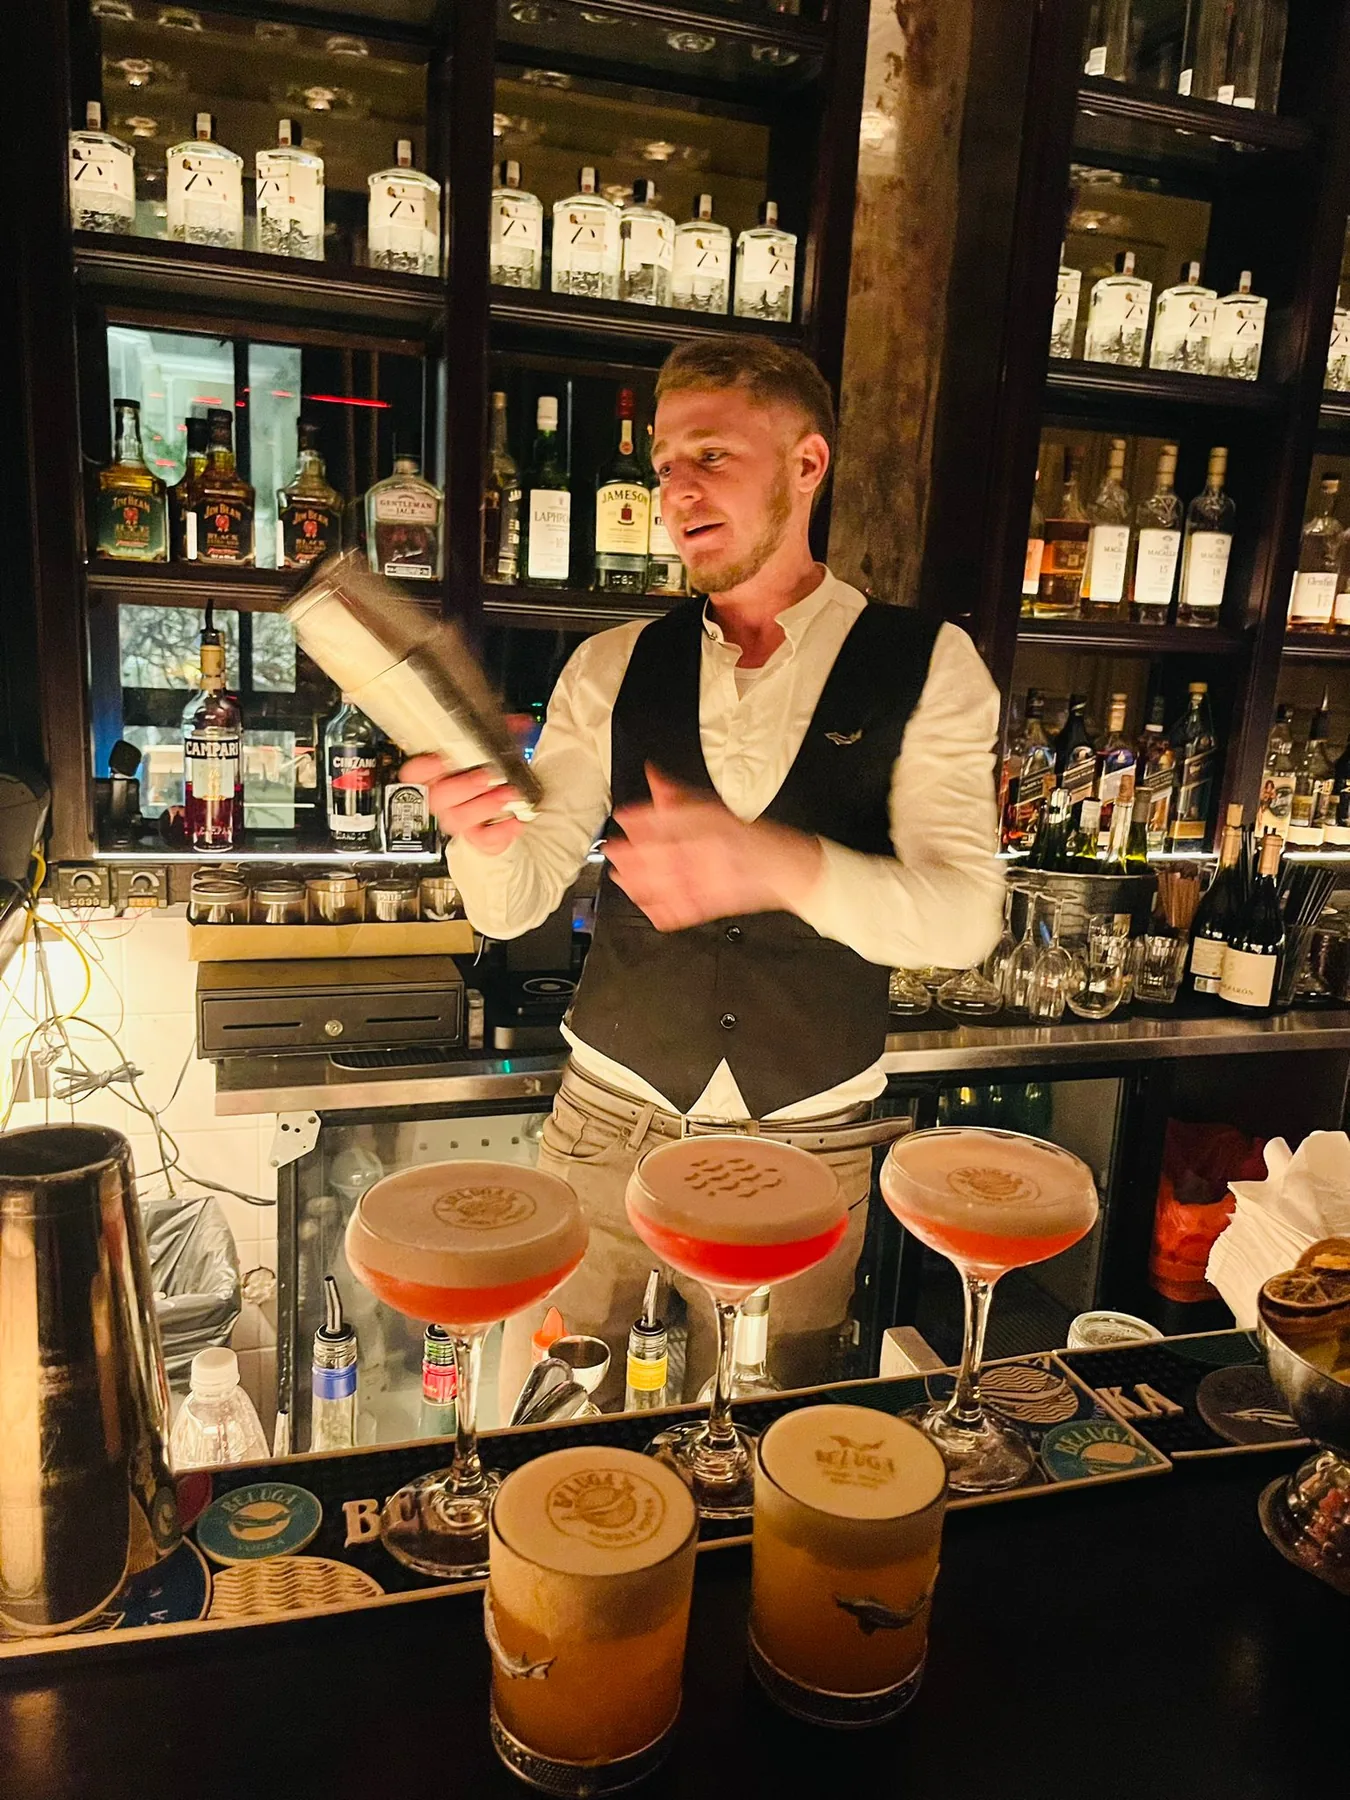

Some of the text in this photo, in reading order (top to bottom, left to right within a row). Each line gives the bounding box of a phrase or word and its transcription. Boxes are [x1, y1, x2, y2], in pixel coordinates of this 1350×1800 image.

[379, 499, 434, 510] GENTLEMAN
[601, 489, 649, 507] JAMESON
[219, 502, 242, 521] BEAM
[185, 741, 239, 758] CAMPARI
[332, 756, 377, 770] CINZANO
[1053, 1425, 1138, 1458] BELUGA
[220, 1487, 299, 1513] BELUGA
